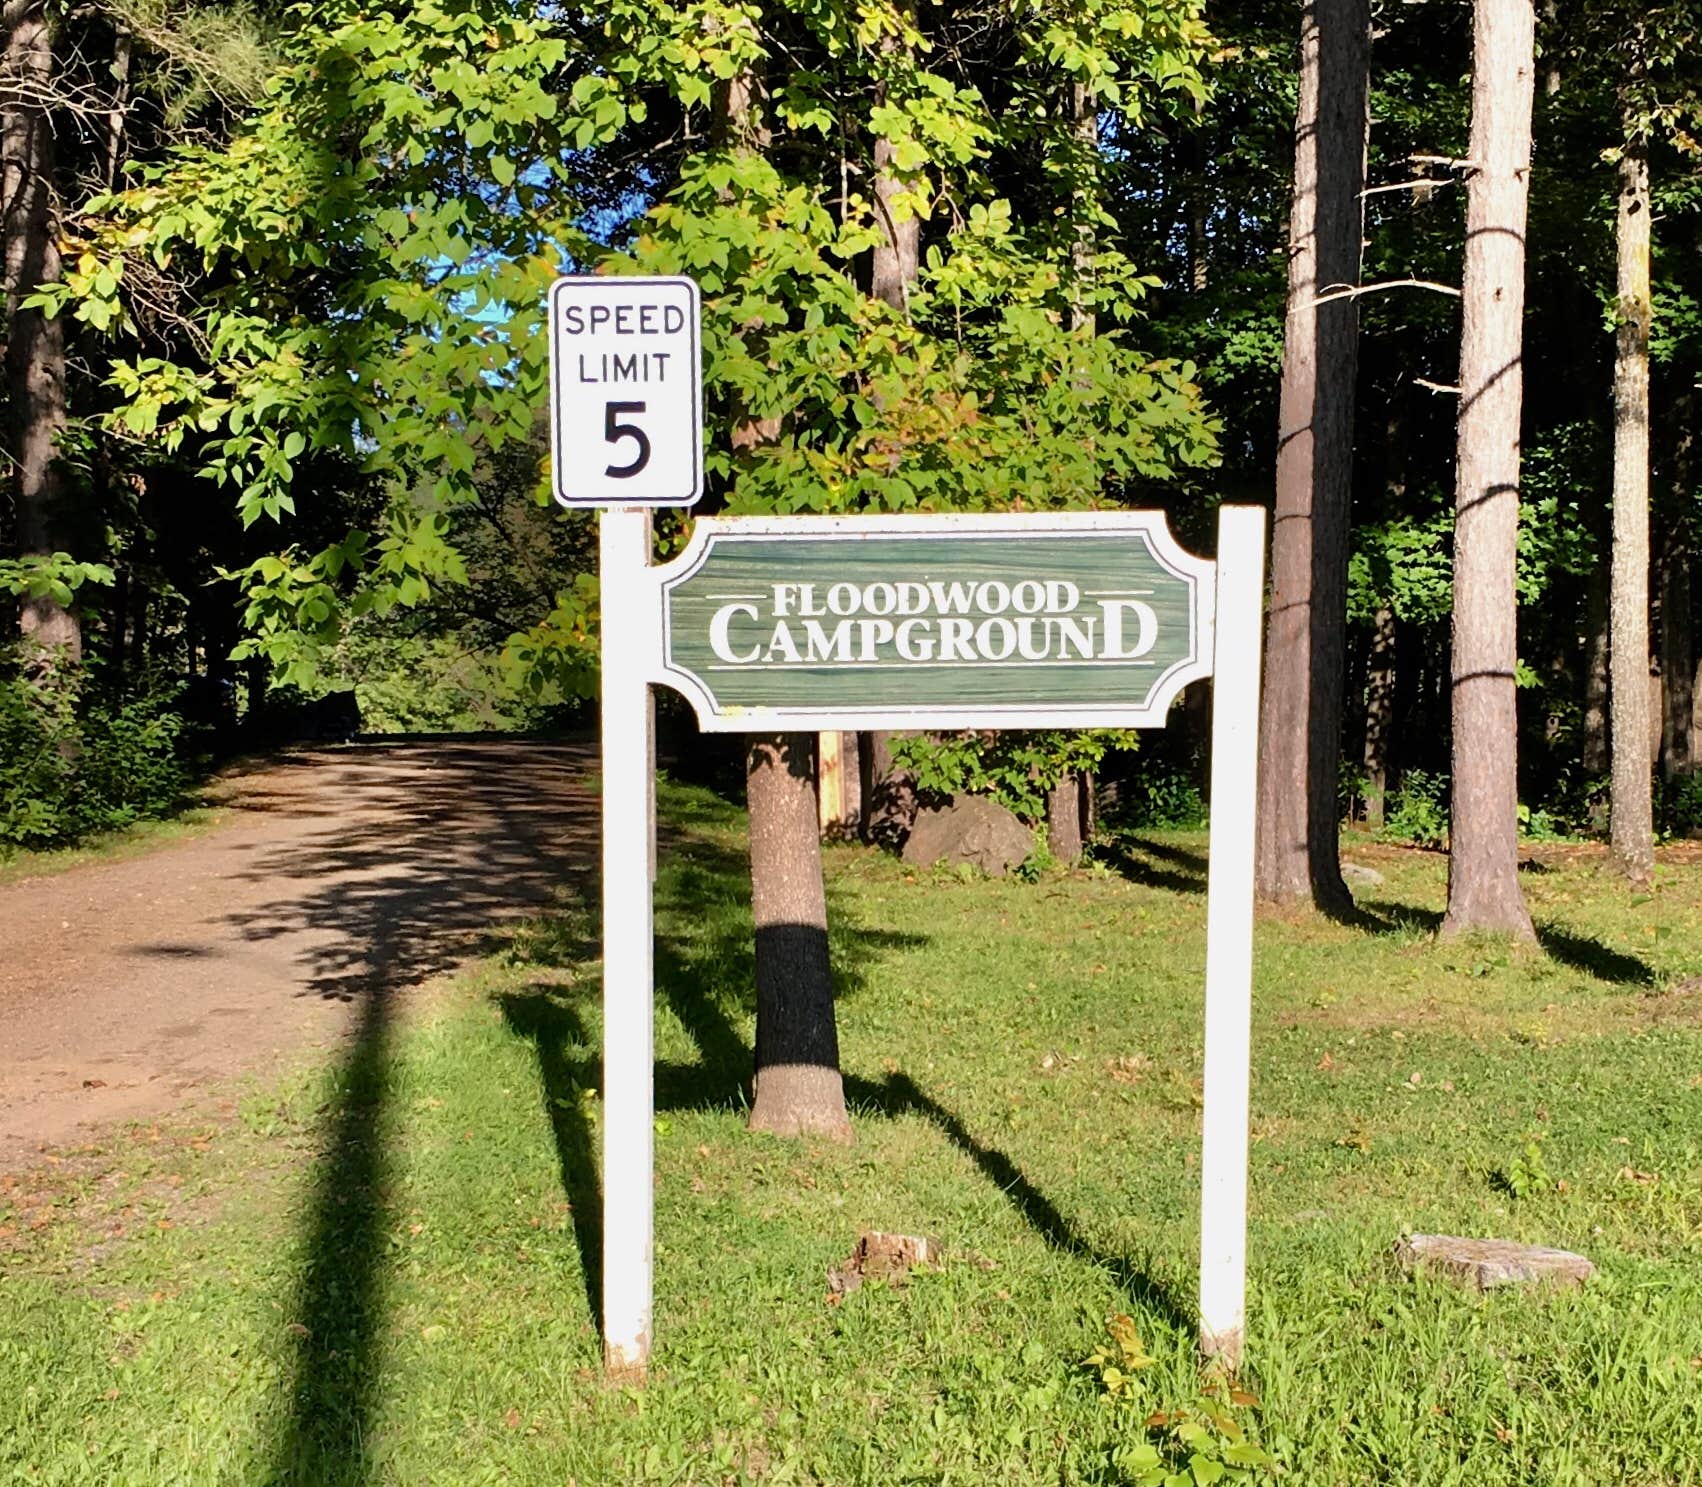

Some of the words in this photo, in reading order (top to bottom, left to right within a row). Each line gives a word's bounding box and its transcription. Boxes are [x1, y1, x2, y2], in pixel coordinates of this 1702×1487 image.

[566, 306, 684, 334] SPEED
[579, 354, 670, 382] LIMIT
[605, 401, 651, 478] 5
[771, 581, 1080, 617] FLOODWOOD
[708, 600, 1159, 664] CAMPGROUND
